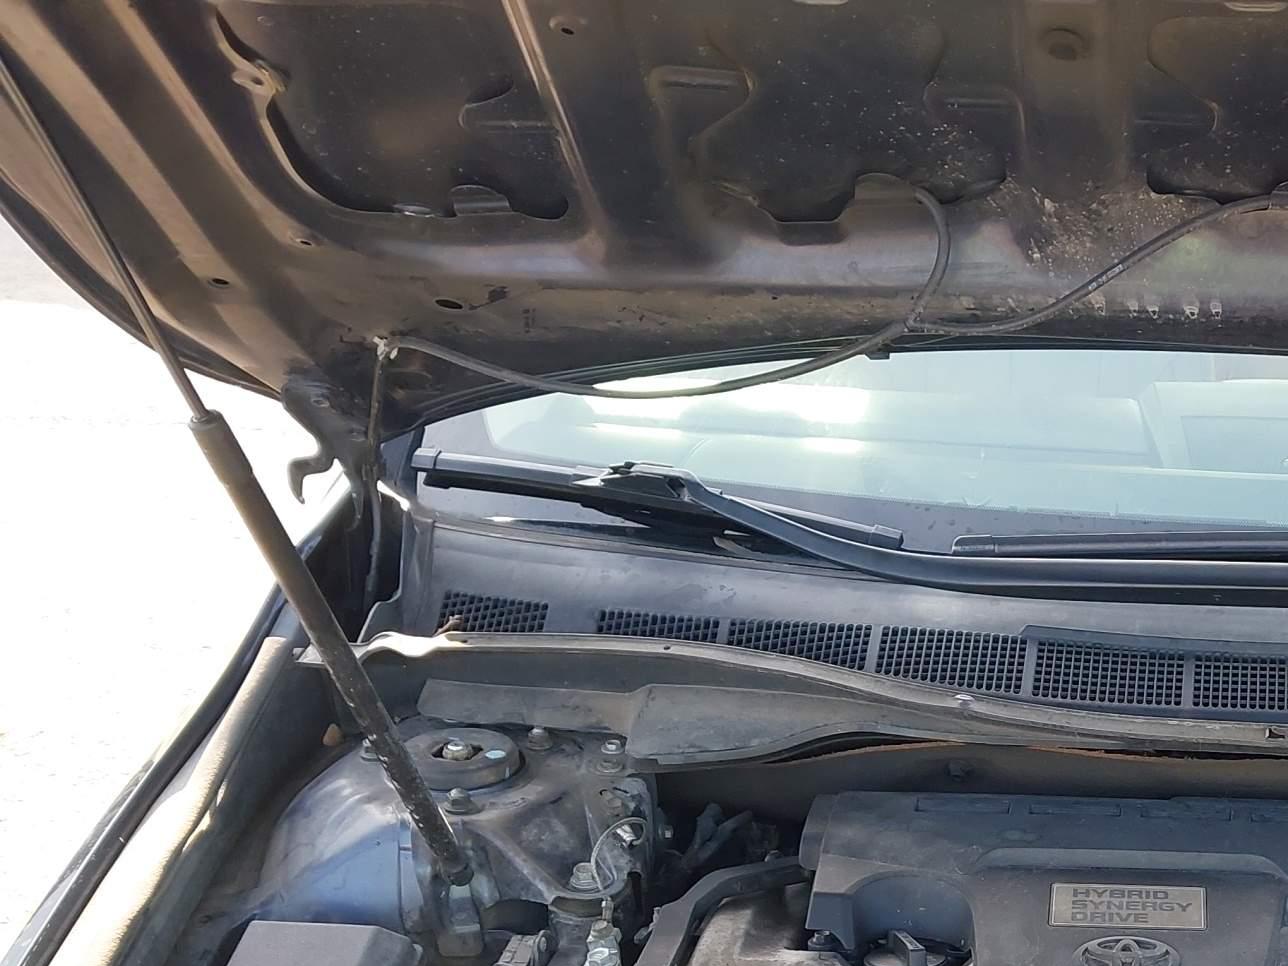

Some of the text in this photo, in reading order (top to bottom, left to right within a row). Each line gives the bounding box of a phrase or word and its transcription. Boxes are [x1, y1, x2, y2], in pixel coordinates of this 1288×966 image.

[1072, 888, 1169, 900] HYBRID
[1071, 899, 1193, 912] SYNERGY
[1071, 911, 1149, 923] DRIVE
